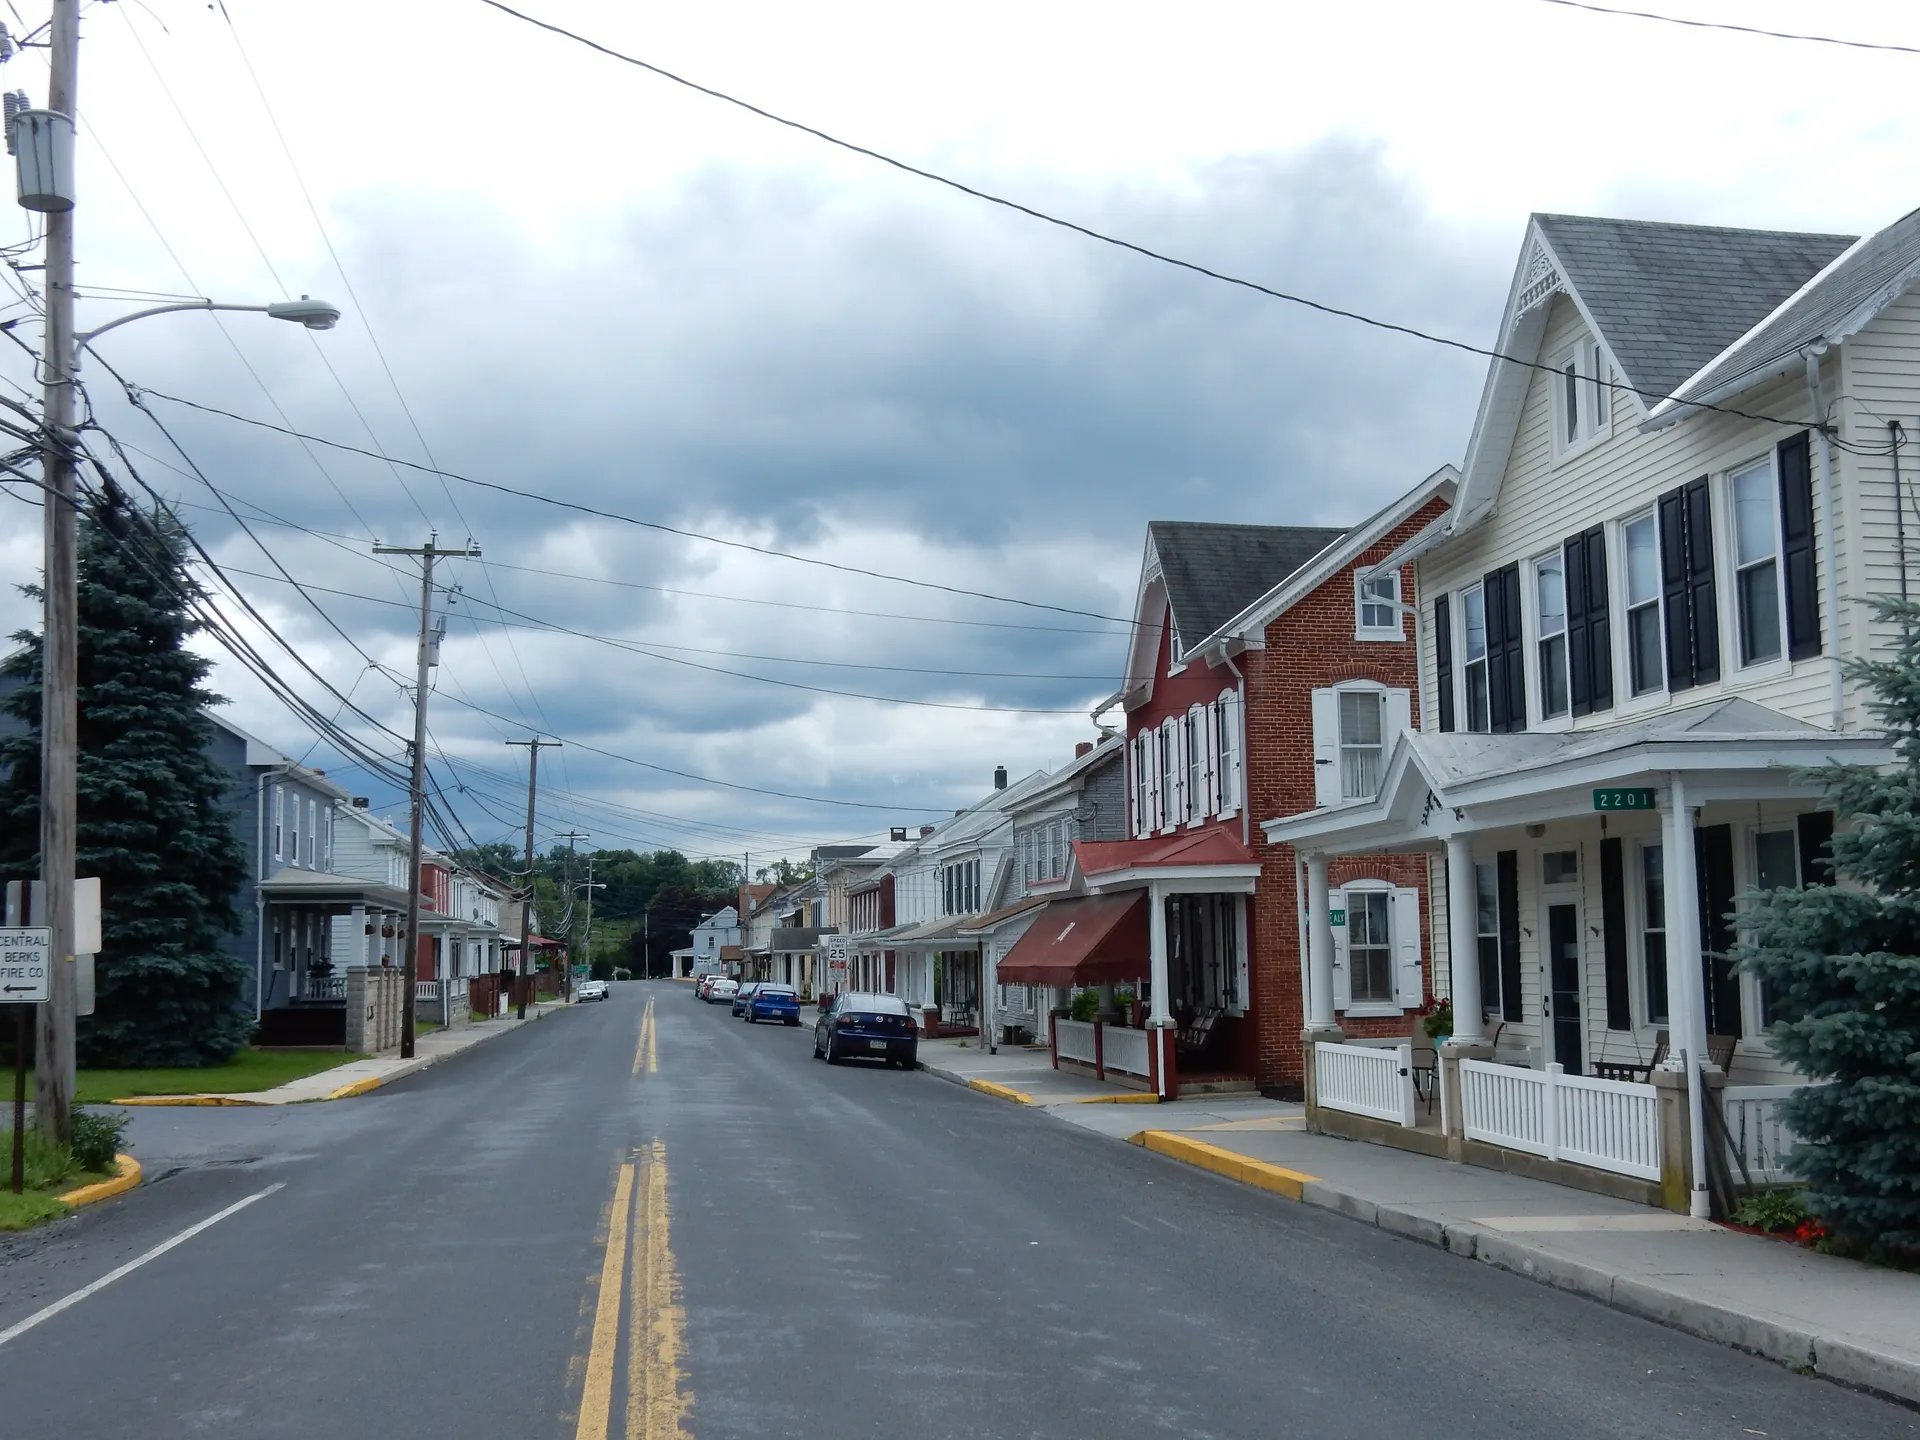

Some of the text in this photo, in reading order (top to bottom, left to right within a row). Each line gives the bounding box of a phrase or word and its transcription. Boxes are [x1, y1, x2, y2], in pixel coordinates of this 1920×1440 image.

[1600, 793, 1648, 807] 2201
[1333, 913, 1345, 923] ALY
[5, 951, 41, 963] BERKS
[830, 949, 845, 958] 25
[0, 967, 24, 978] FIRE
